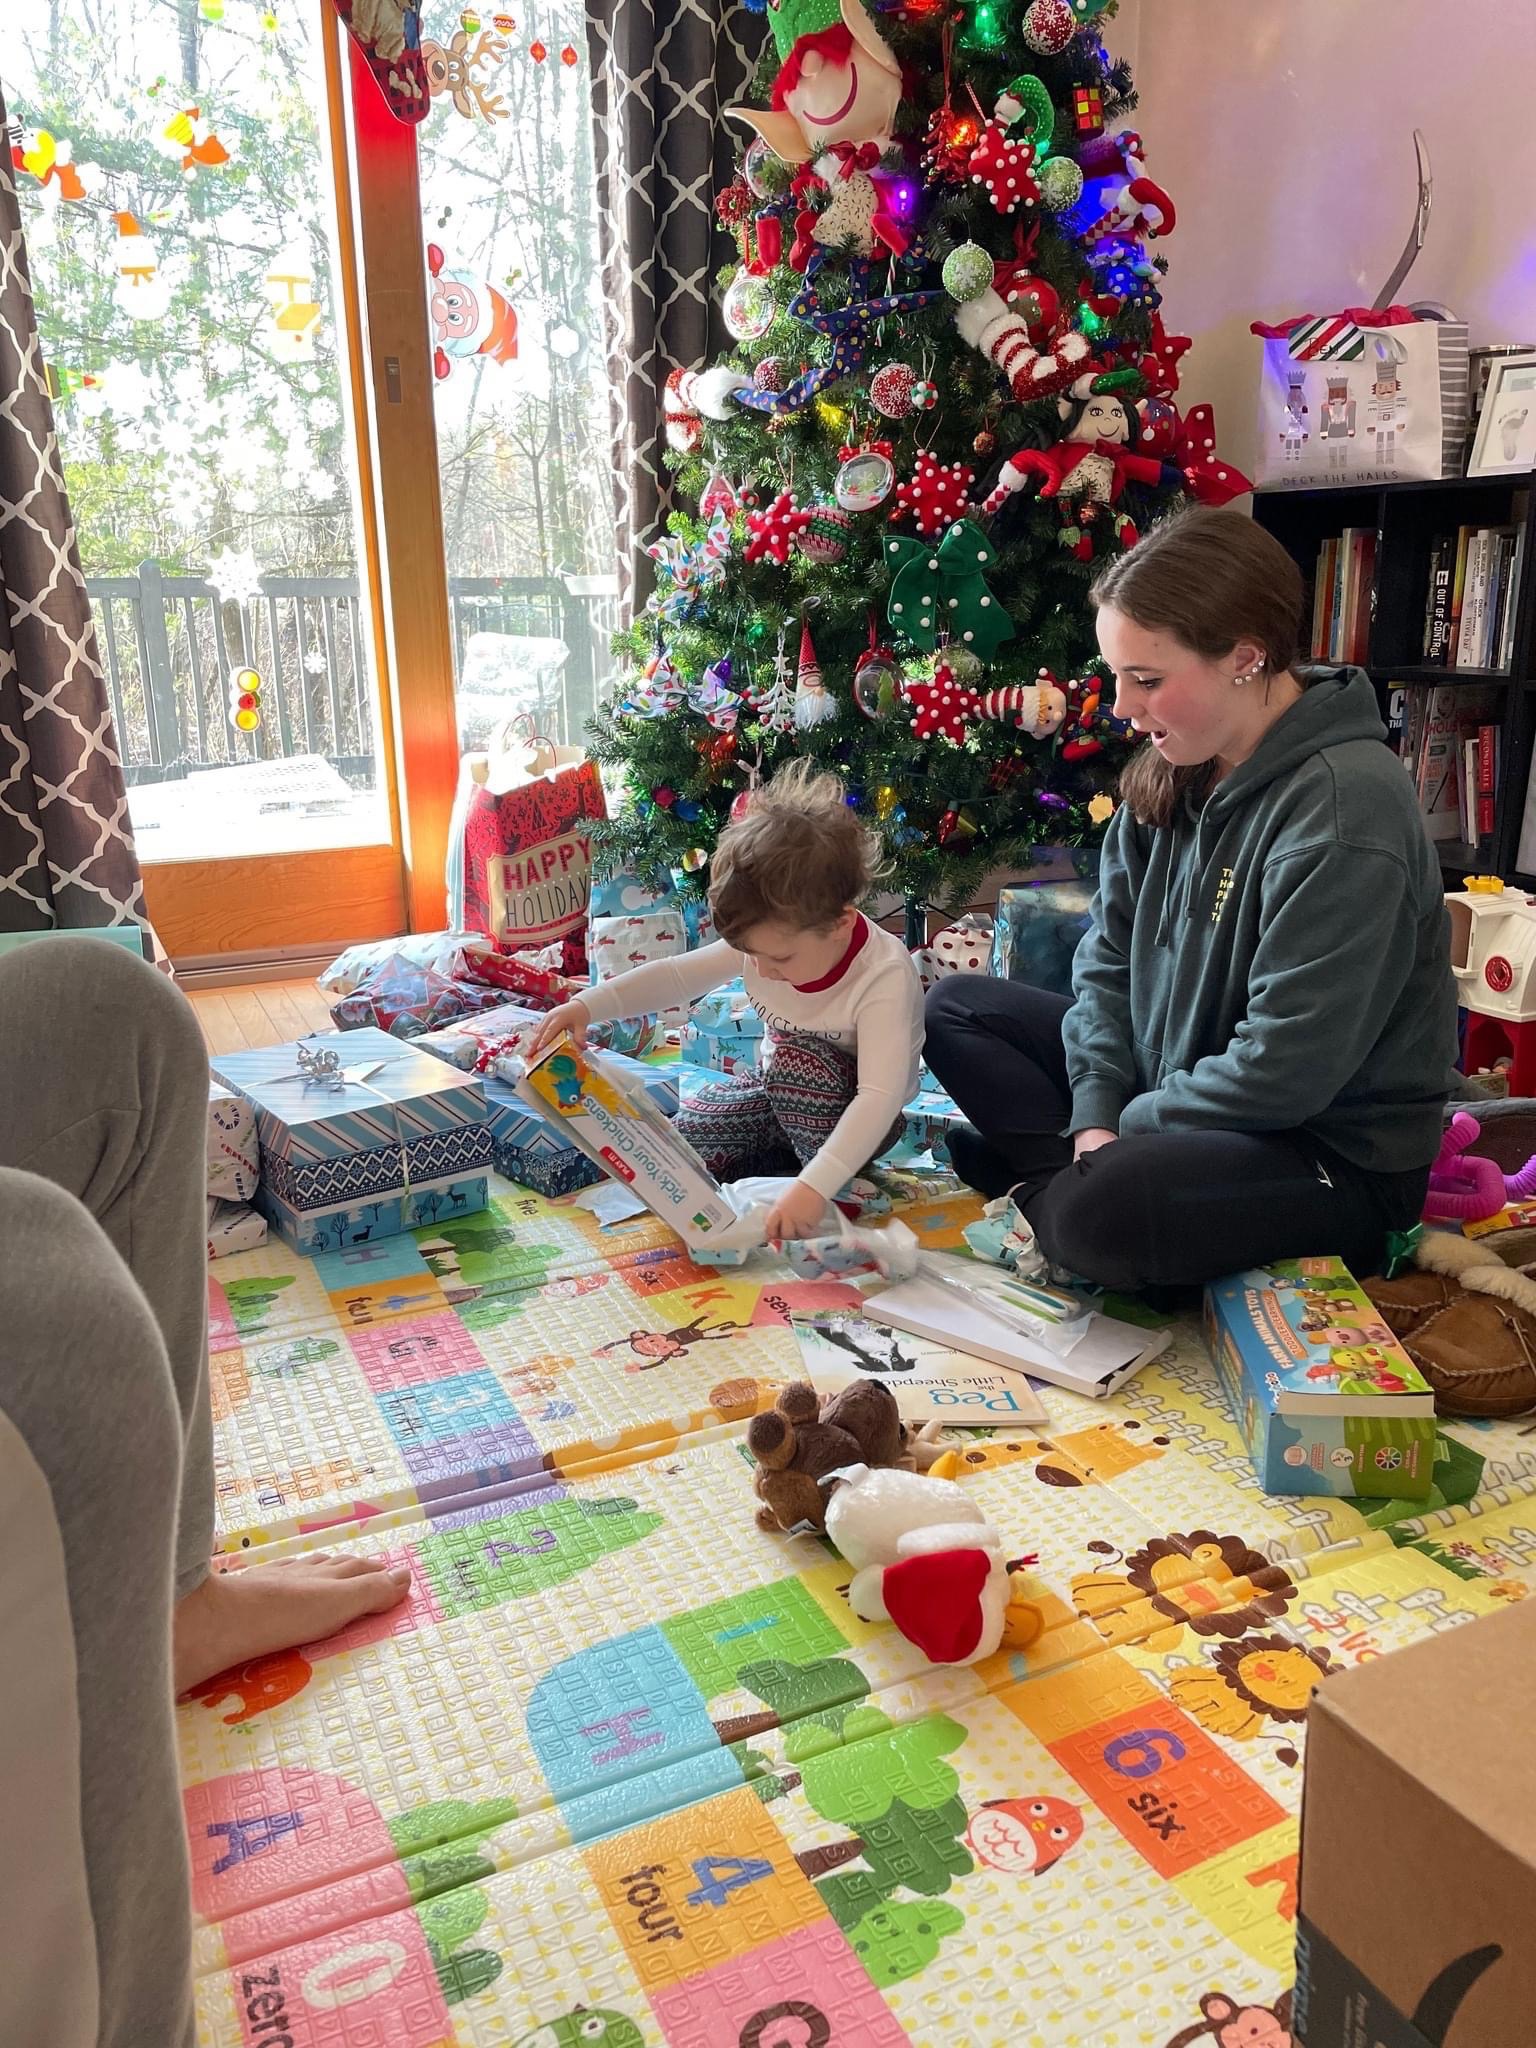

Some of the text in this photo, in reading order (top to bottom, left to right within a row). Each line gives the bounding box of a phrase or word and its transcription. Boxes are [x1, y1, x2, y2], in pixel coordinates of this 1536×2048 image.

[1281, 470, 1400, 487] DECK THE HALLS
[1436, 588, 1447, 606] OUT
[1435, 608, 1445, 619] OF
[1430, 621, 1443, 658] CONTROL
[502, 836, 591, 891] HAPPY
[505, 874, 588, 928] HOLIDAY
[583, 1097, 635, 1153] Chickens
[617, 1160, 631, 1176] PLAY
[633, 1149, 662, 1181] Your
[660, 1175, 686, 1205] Pick
[514, 1198, 539, 1217] five
[682, 1286, 735, 1311] K
[1244, 1289, 1260, 1310] TOYS
[1250, 1310, 1278, 1345] ANIMALS
[1277, 1324, 1298, 1354] TODDLER
[1268, 1344, 1295, 1369] FARM
[882, 1376, 1007, 1388] Little Sheepdo
[928, 1388, 1023, 1412] Peg
[580, 1706, 666, 1765] H
[1103, 1727, 1187, 1778] 6
[1127, 1791, 1186, 1842] six
[687, 1855, 775, 1909] 4
[619, 1863, 684, 1943] four
